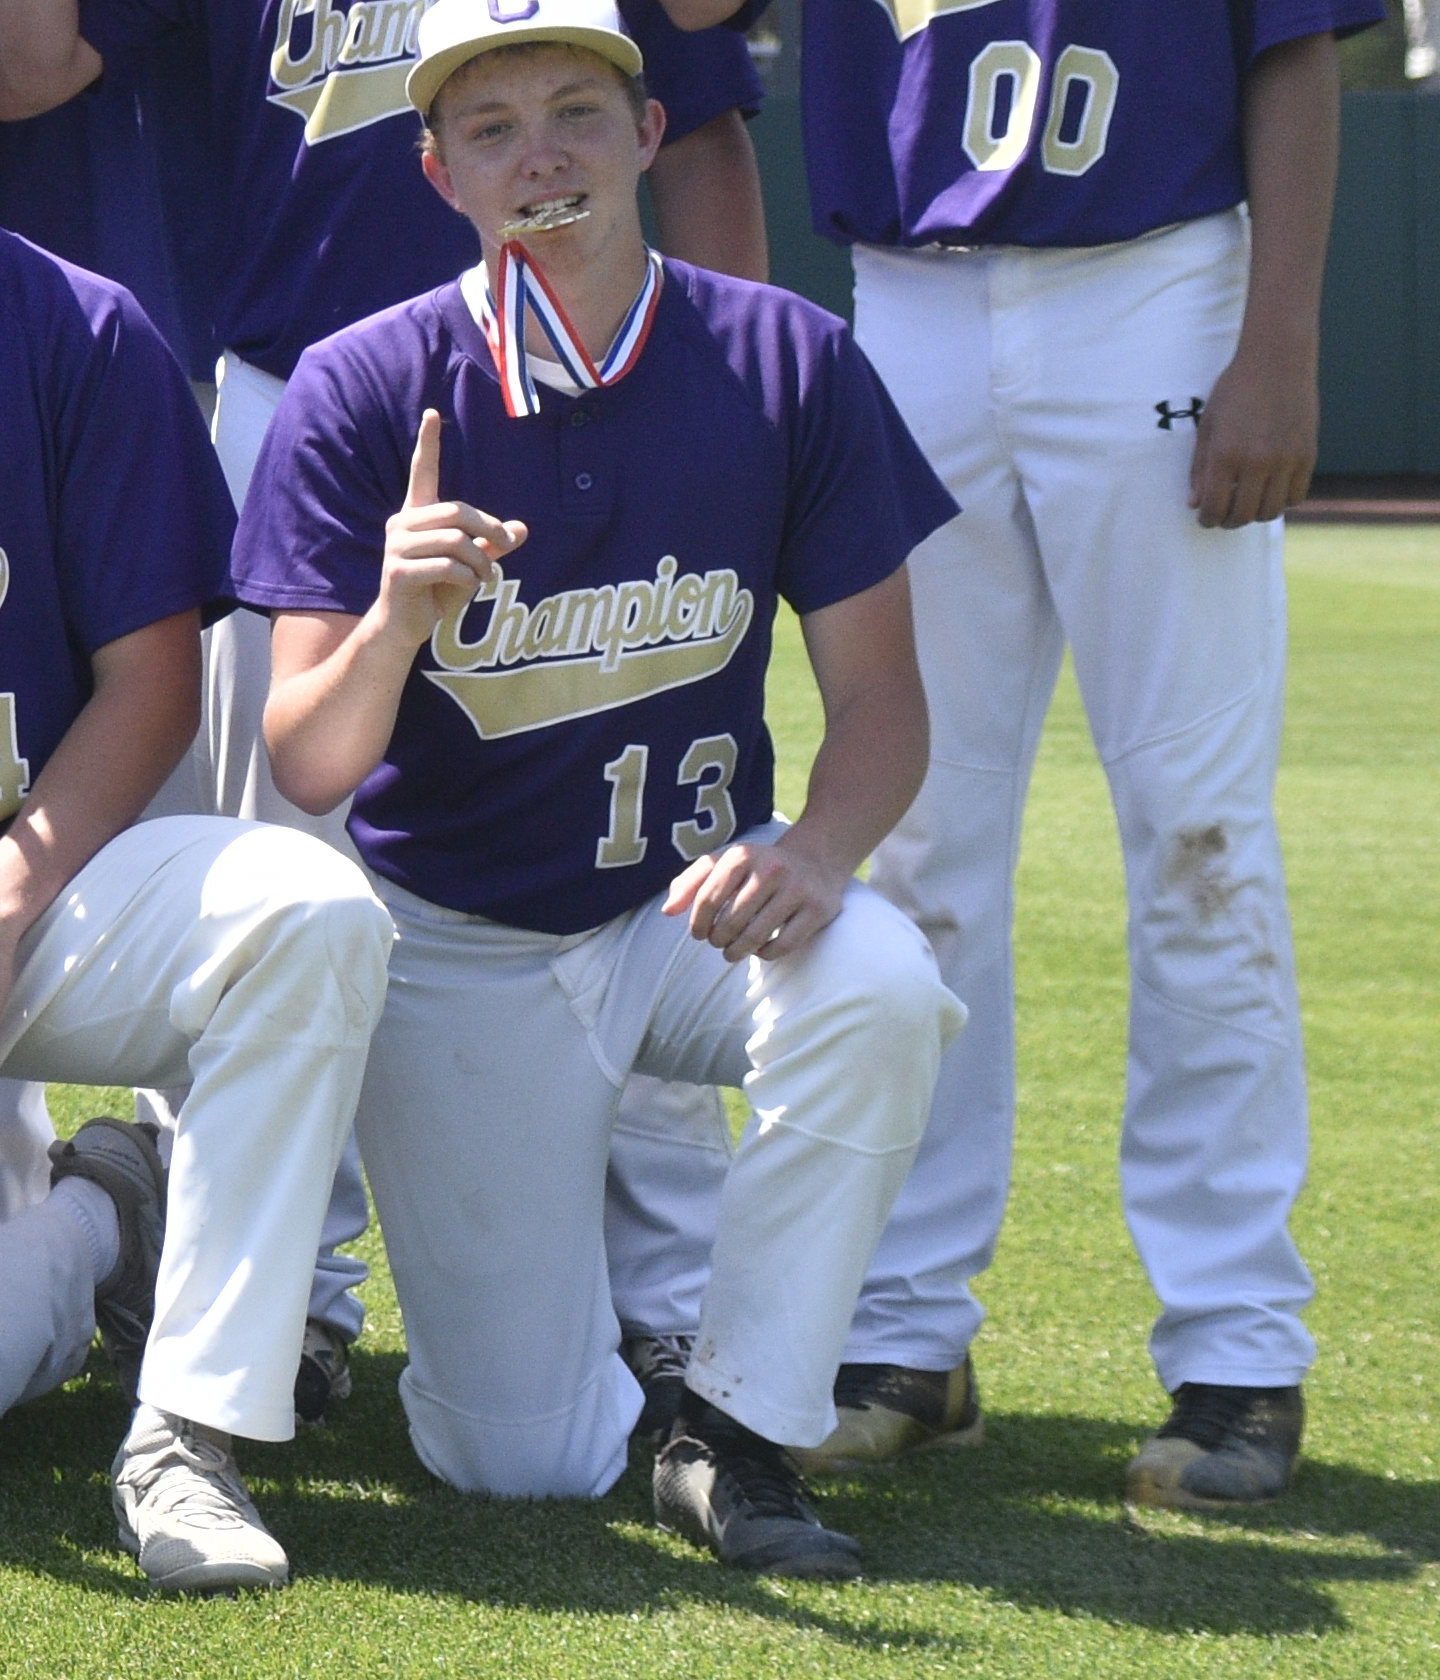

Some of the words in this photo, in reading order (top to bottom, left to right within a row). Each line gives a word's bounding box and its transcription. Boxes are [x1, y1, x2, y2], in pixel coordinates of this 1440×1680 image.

[961, 40, 1120, 177] 00
[431, 554, 753, 674] Champion
[595, 732, 739, 870] 13
